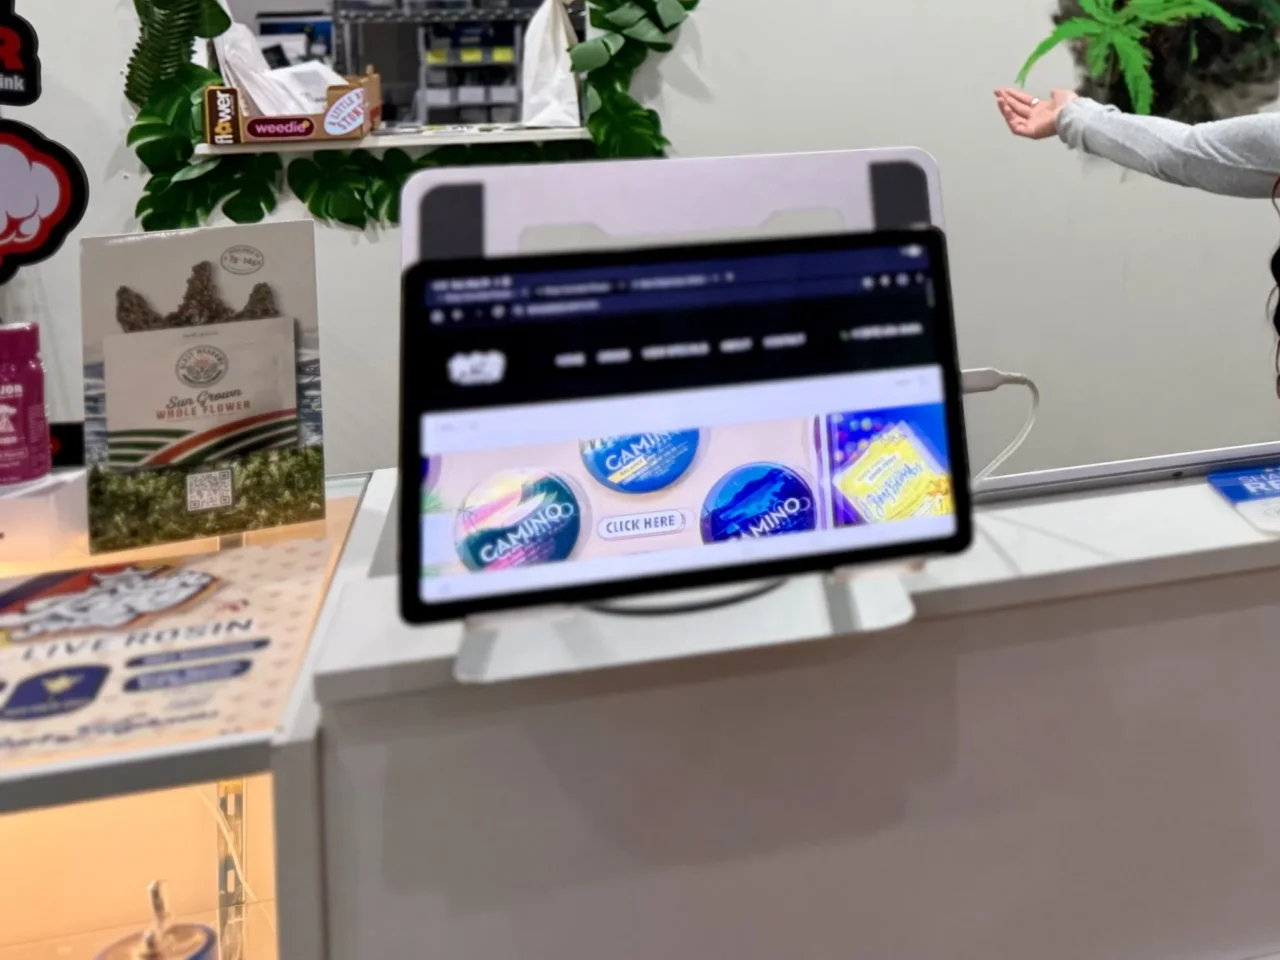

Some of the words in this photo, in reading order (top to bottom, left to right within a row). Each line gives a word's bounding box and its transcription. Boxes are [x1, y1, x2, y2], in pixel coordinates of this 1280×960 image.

[255, 121, 306, 134] weedie
[155, 406, 198, 420] WHOLE
[202, 399, 251, 415] FLOWER
[165, 396, 195, 410] Sun
[196, 388, 243, 408] Grown
[605, 519, 640, 534] CLICK
[644, 515, 675, 530] HERE
[125, 618, 254, 647] ROSIN
